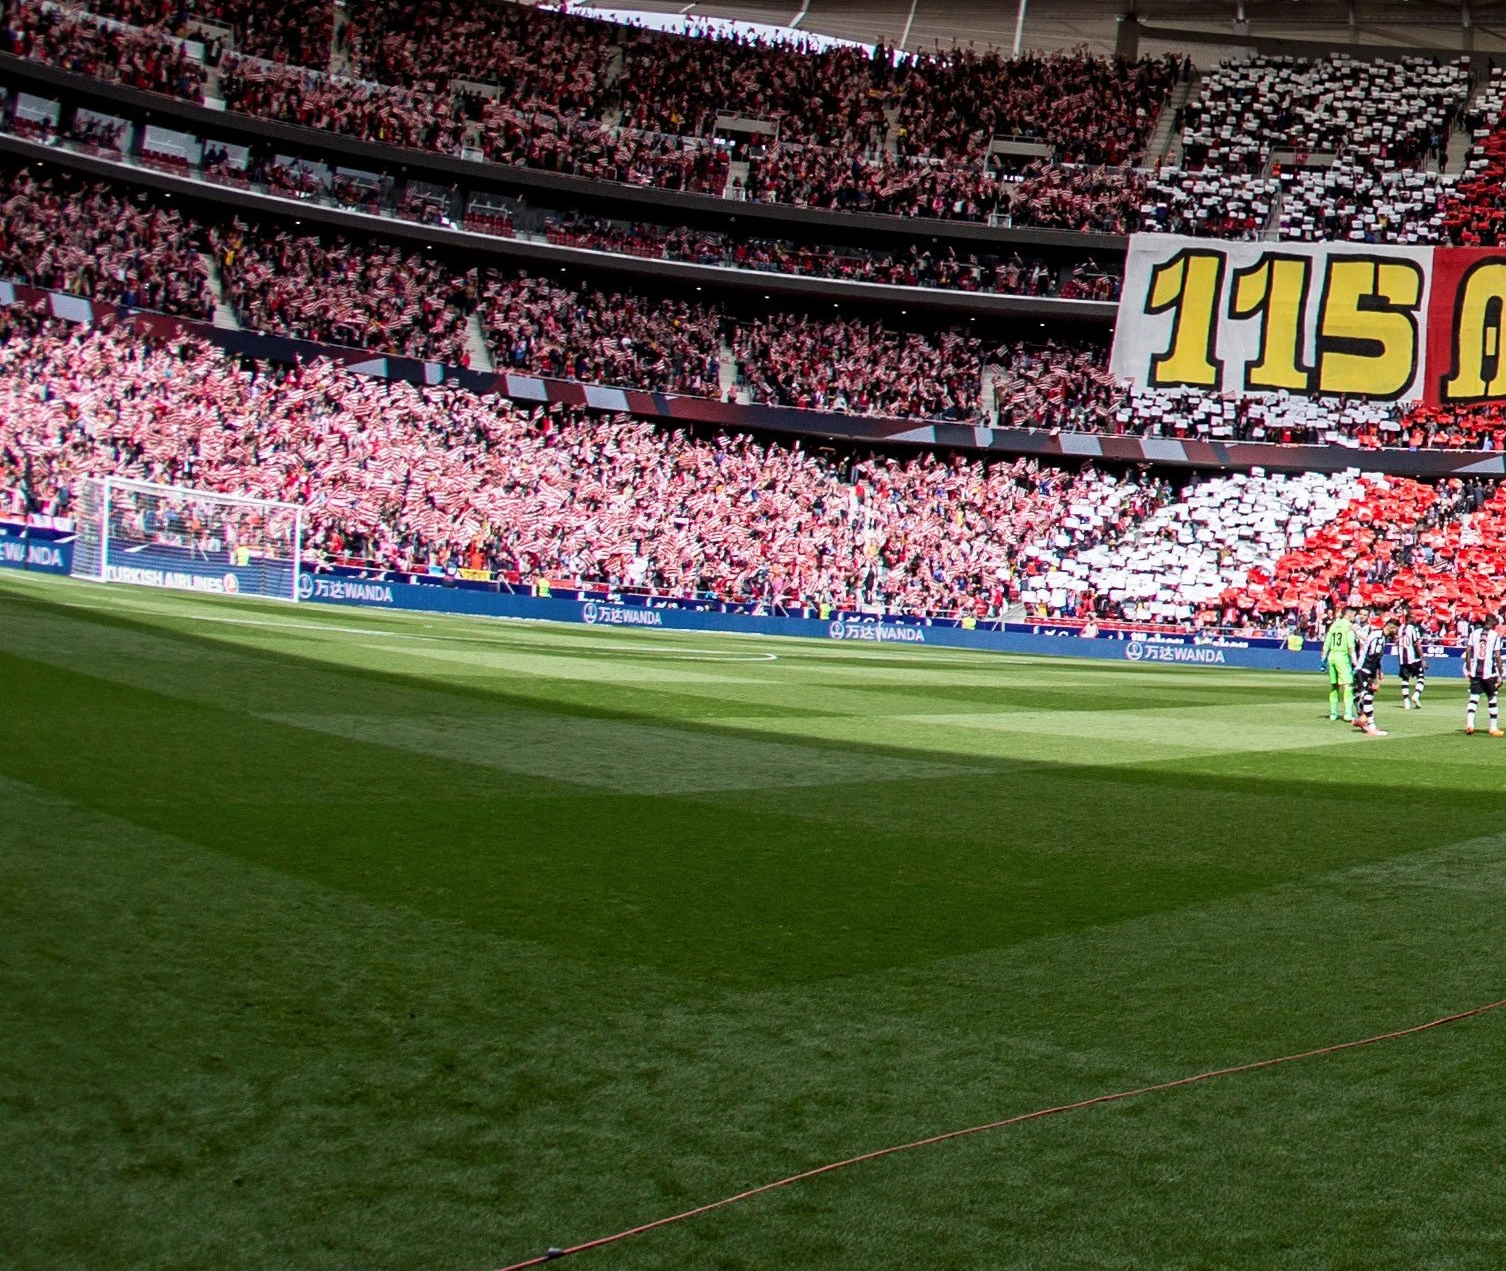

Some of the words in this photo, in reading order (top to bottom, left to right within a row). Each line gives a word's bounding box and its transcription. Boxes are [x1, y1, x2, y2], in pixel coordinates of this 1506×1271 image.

[1143, 246, 1425, 402] 115
[107, 565, 164, 588] TURKISH
[164, 572, 223, 593] AIRLINES
[1332, 632, 1343, 647] 13
